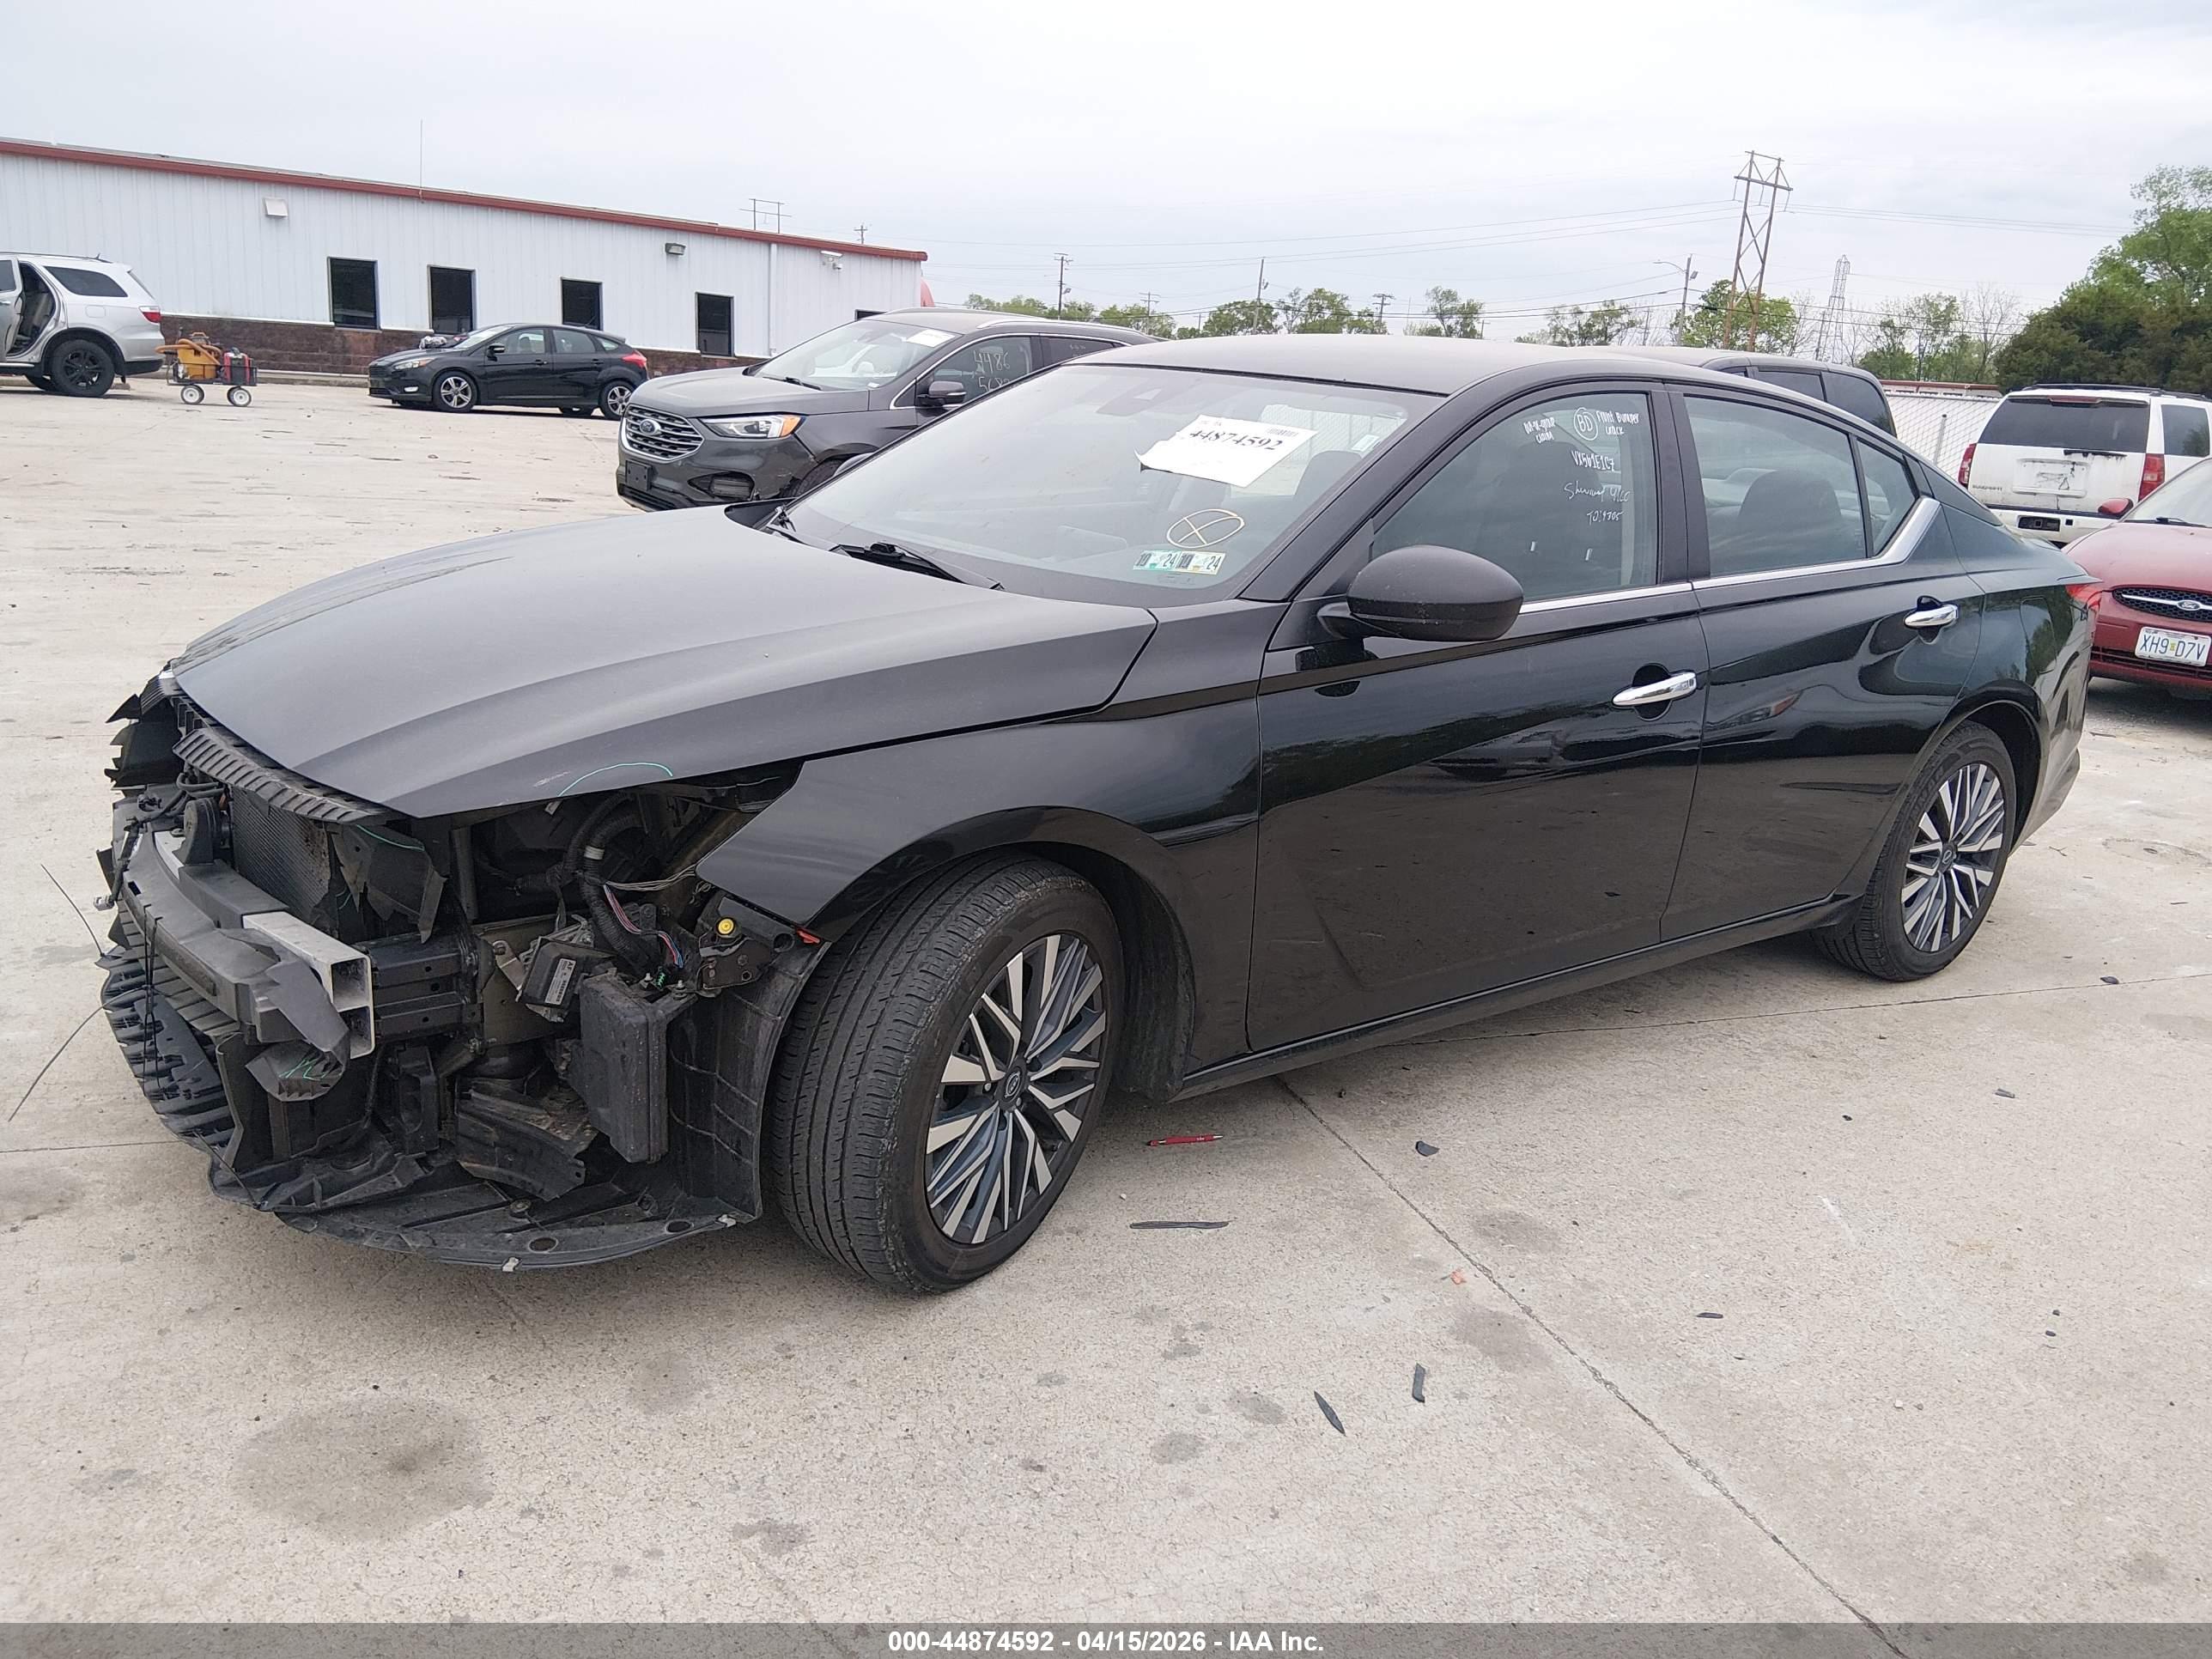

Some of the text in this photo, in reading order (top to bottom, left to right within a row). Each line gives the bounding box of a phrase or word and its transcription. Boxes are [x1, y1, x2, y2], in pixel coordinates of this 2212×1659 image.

[973, 350, 1011, 374] 4486
[1189, 430, 1283, 450] 44874592
[1163, 553, 1178, 568] 24
[1206, 556, 1221, 570] 24
[2140, 635, 2205, 659] XH9 D7V
